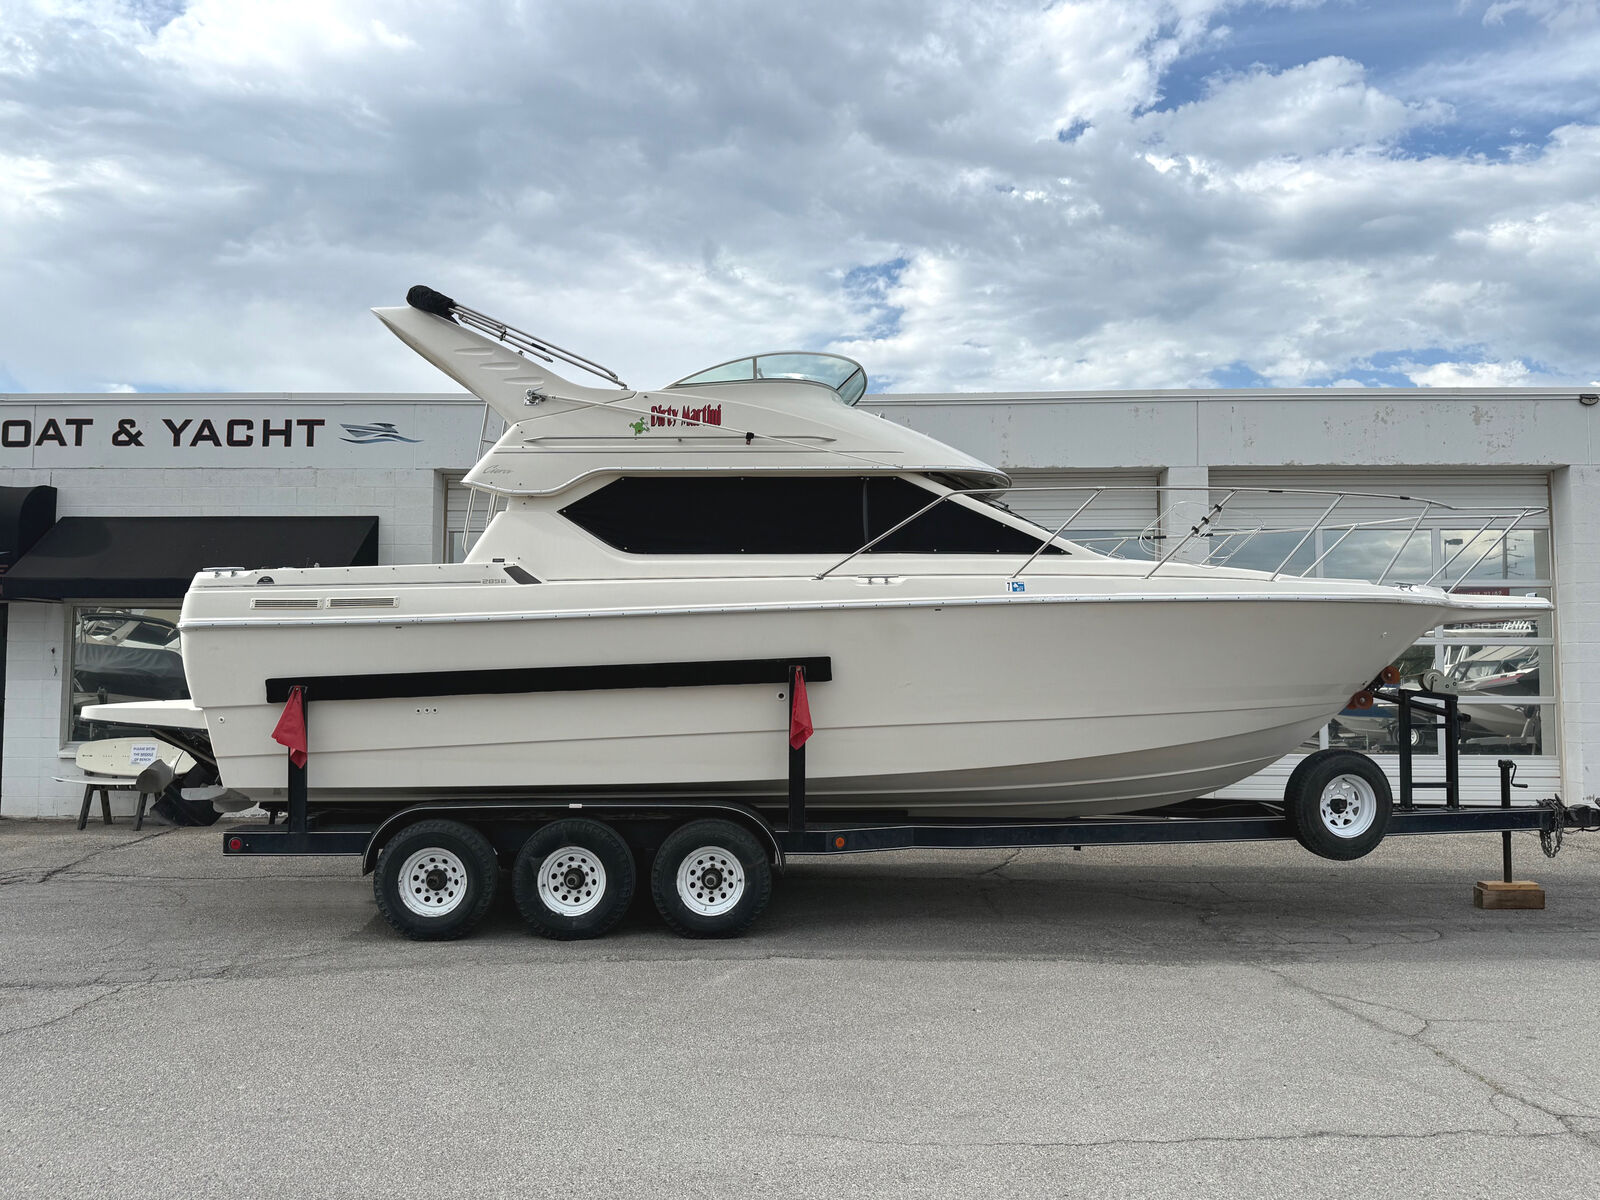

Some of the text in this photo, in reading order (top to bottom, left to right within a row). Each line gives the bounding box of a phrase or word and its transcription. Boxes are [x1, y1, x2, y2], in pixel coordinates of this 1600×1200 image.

[651, 403, 722, 427] Dirty Martini
[1, 418, 326, 448] OAT & YACHT
